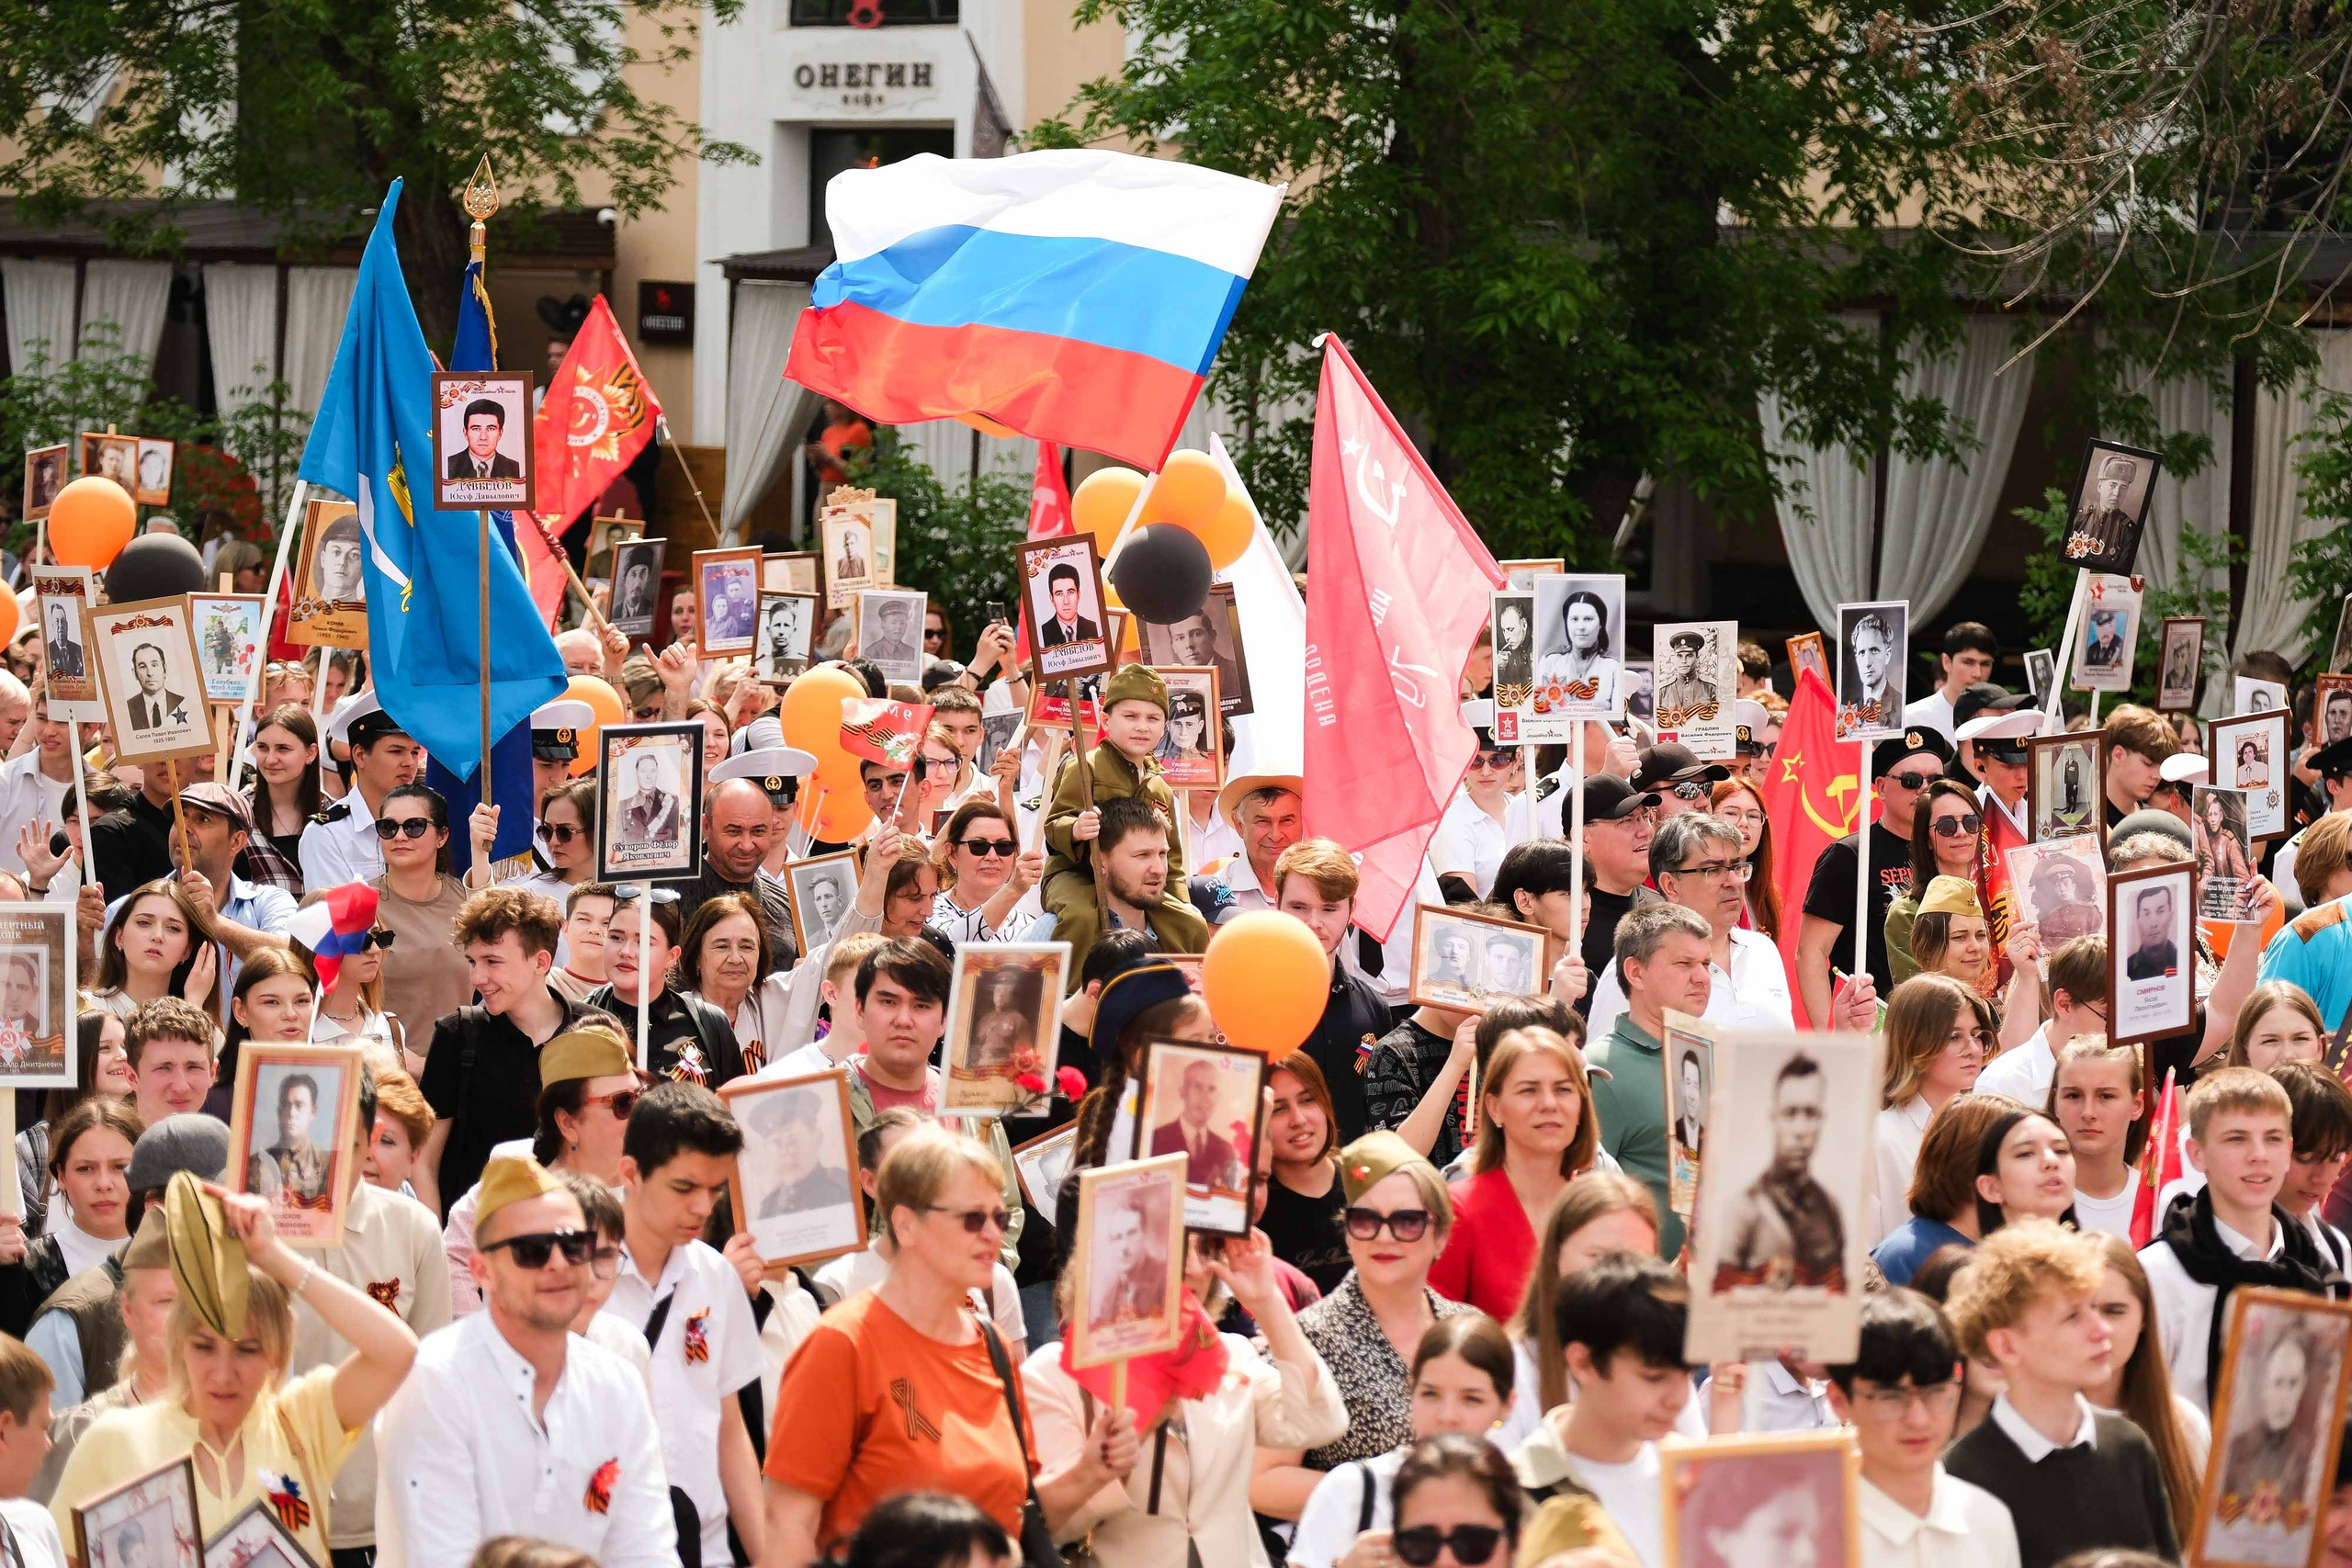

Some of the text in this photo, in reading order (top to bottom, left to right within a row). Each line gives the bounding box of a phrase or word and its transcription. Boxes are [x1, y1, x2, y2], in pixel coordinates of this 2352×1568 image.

[794, 62, 933, 89] ОНЕГИН
[456, 481, 513, 492] ДАВЫДОВ
[449, 492, 520, 502] Юсуф Давыдович
[1052, 643, 1094, 659] ДАВЫДОВ
[1047, 653, 1102, 669] Юсуф Давыдович
[612, 842, 650, 852] Суворов
[621, 851, 671, 862] Яковлевич
[2136, 984, 2165, 996] СМИРНОВ
[19, 1059, 63, 1070] Дмитриевич
